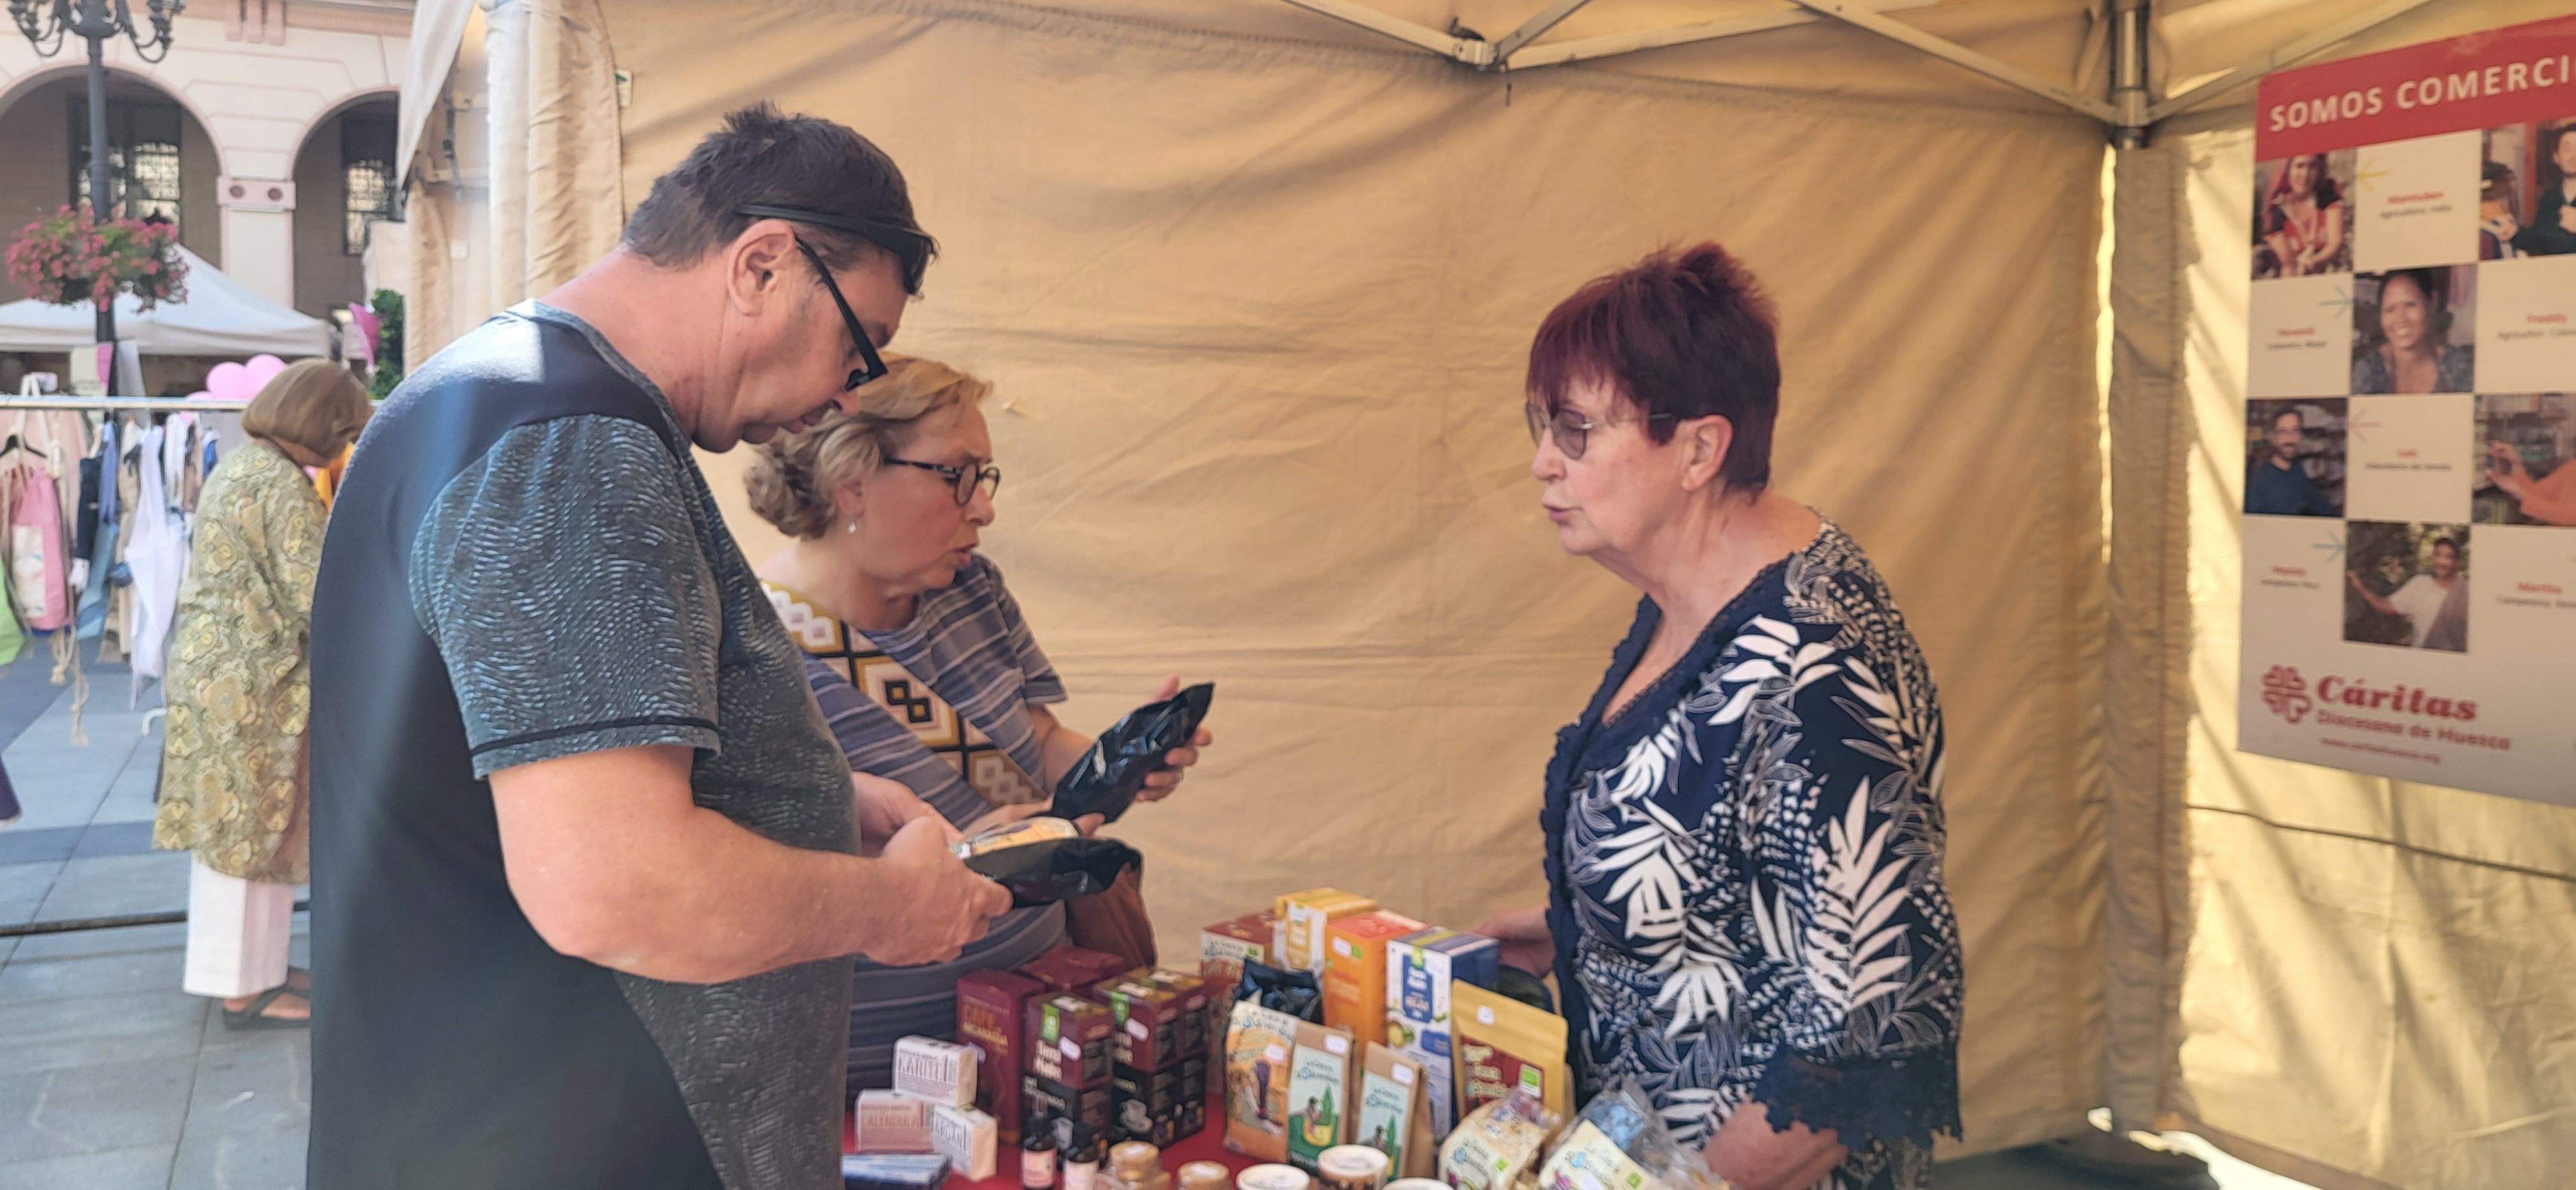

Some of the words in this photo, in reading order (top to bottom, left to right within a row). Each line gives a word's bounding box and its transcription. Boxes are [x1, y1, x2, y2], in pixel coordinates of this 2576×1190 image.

[2269, 86, 2383, 133] SOMOS
[2396, 52, 2576, 109] COMERCI
[2317, 675, 2477, 721] Cáritas
[2438, 726, 2510, 751] Huesca
